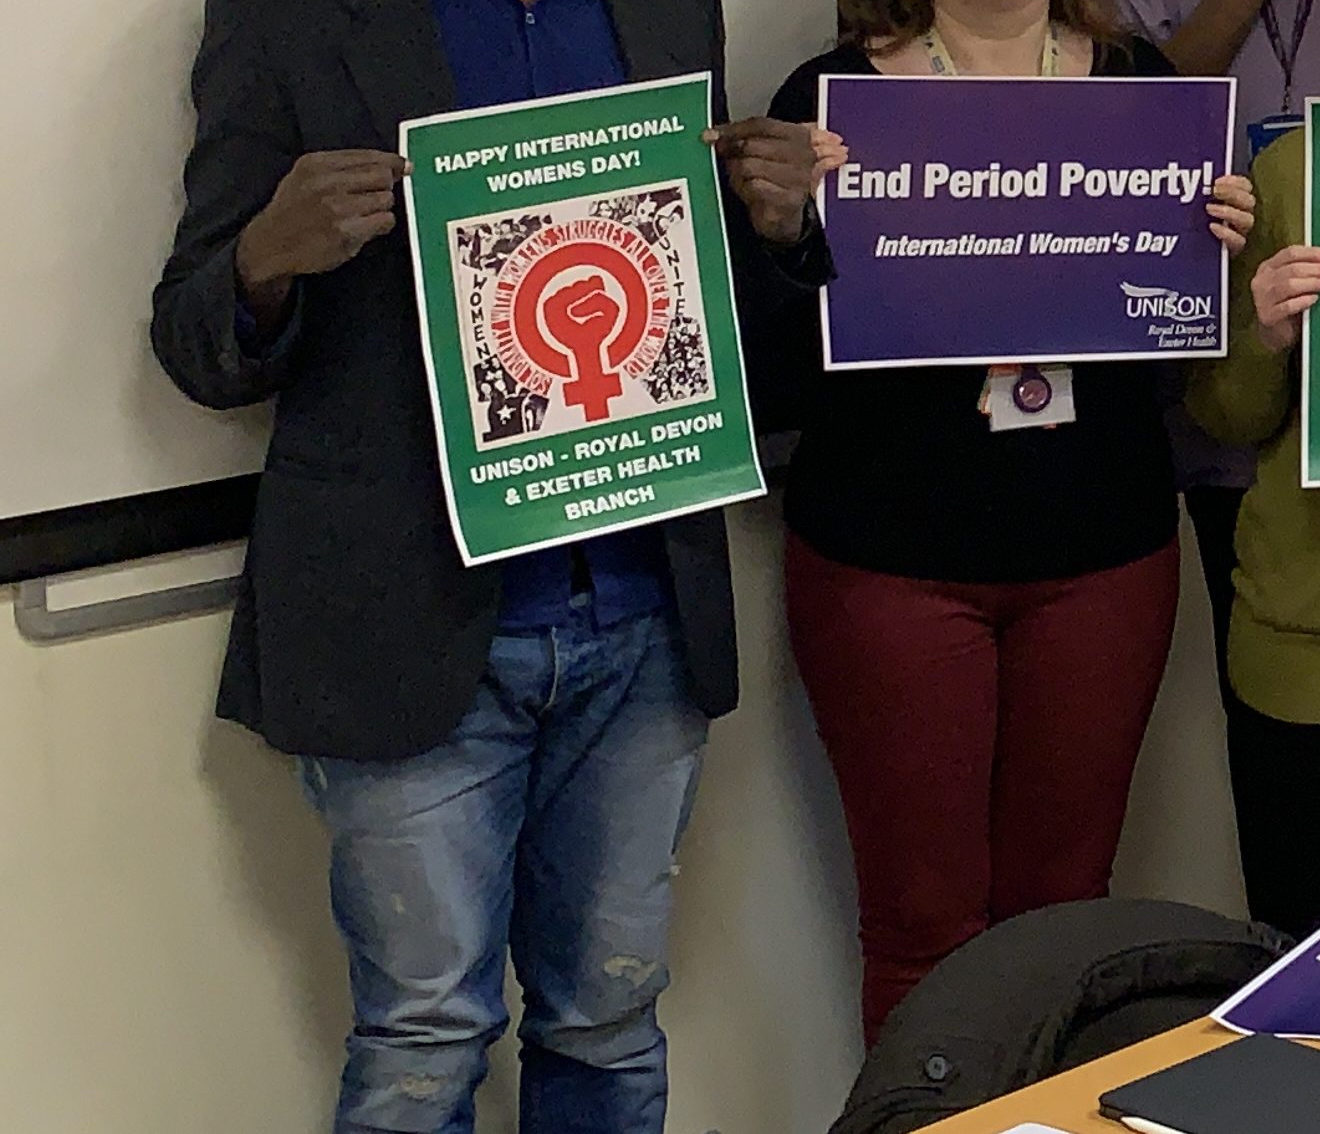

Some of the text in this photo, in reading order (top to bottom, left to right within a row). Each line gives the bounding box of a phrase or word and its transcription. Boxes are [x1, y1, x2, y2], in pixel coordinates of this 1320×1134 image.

[435, 116, 684, 173] HAPPY INTERNATIONAL
[487, 151, 640, 192] WOMENS DAY!
[838, 162, 1212, 202] End Period Poverty!
[876, 232, 1178, 257] International Women's Day
[659, 236, 686, 316] UNITE
[470, 273, 490, 359] WOMEN
[1127, 296, 1211, 318] UNISON
[471, 450, 554, 483] UNISON
[575, 431, 645, 460] ROYAL
[651, 412, 722, 442] DEVON
[505, 446, 700, 505] & EXETER HEALTH
[565, 485, 655, 520] BRANCH
